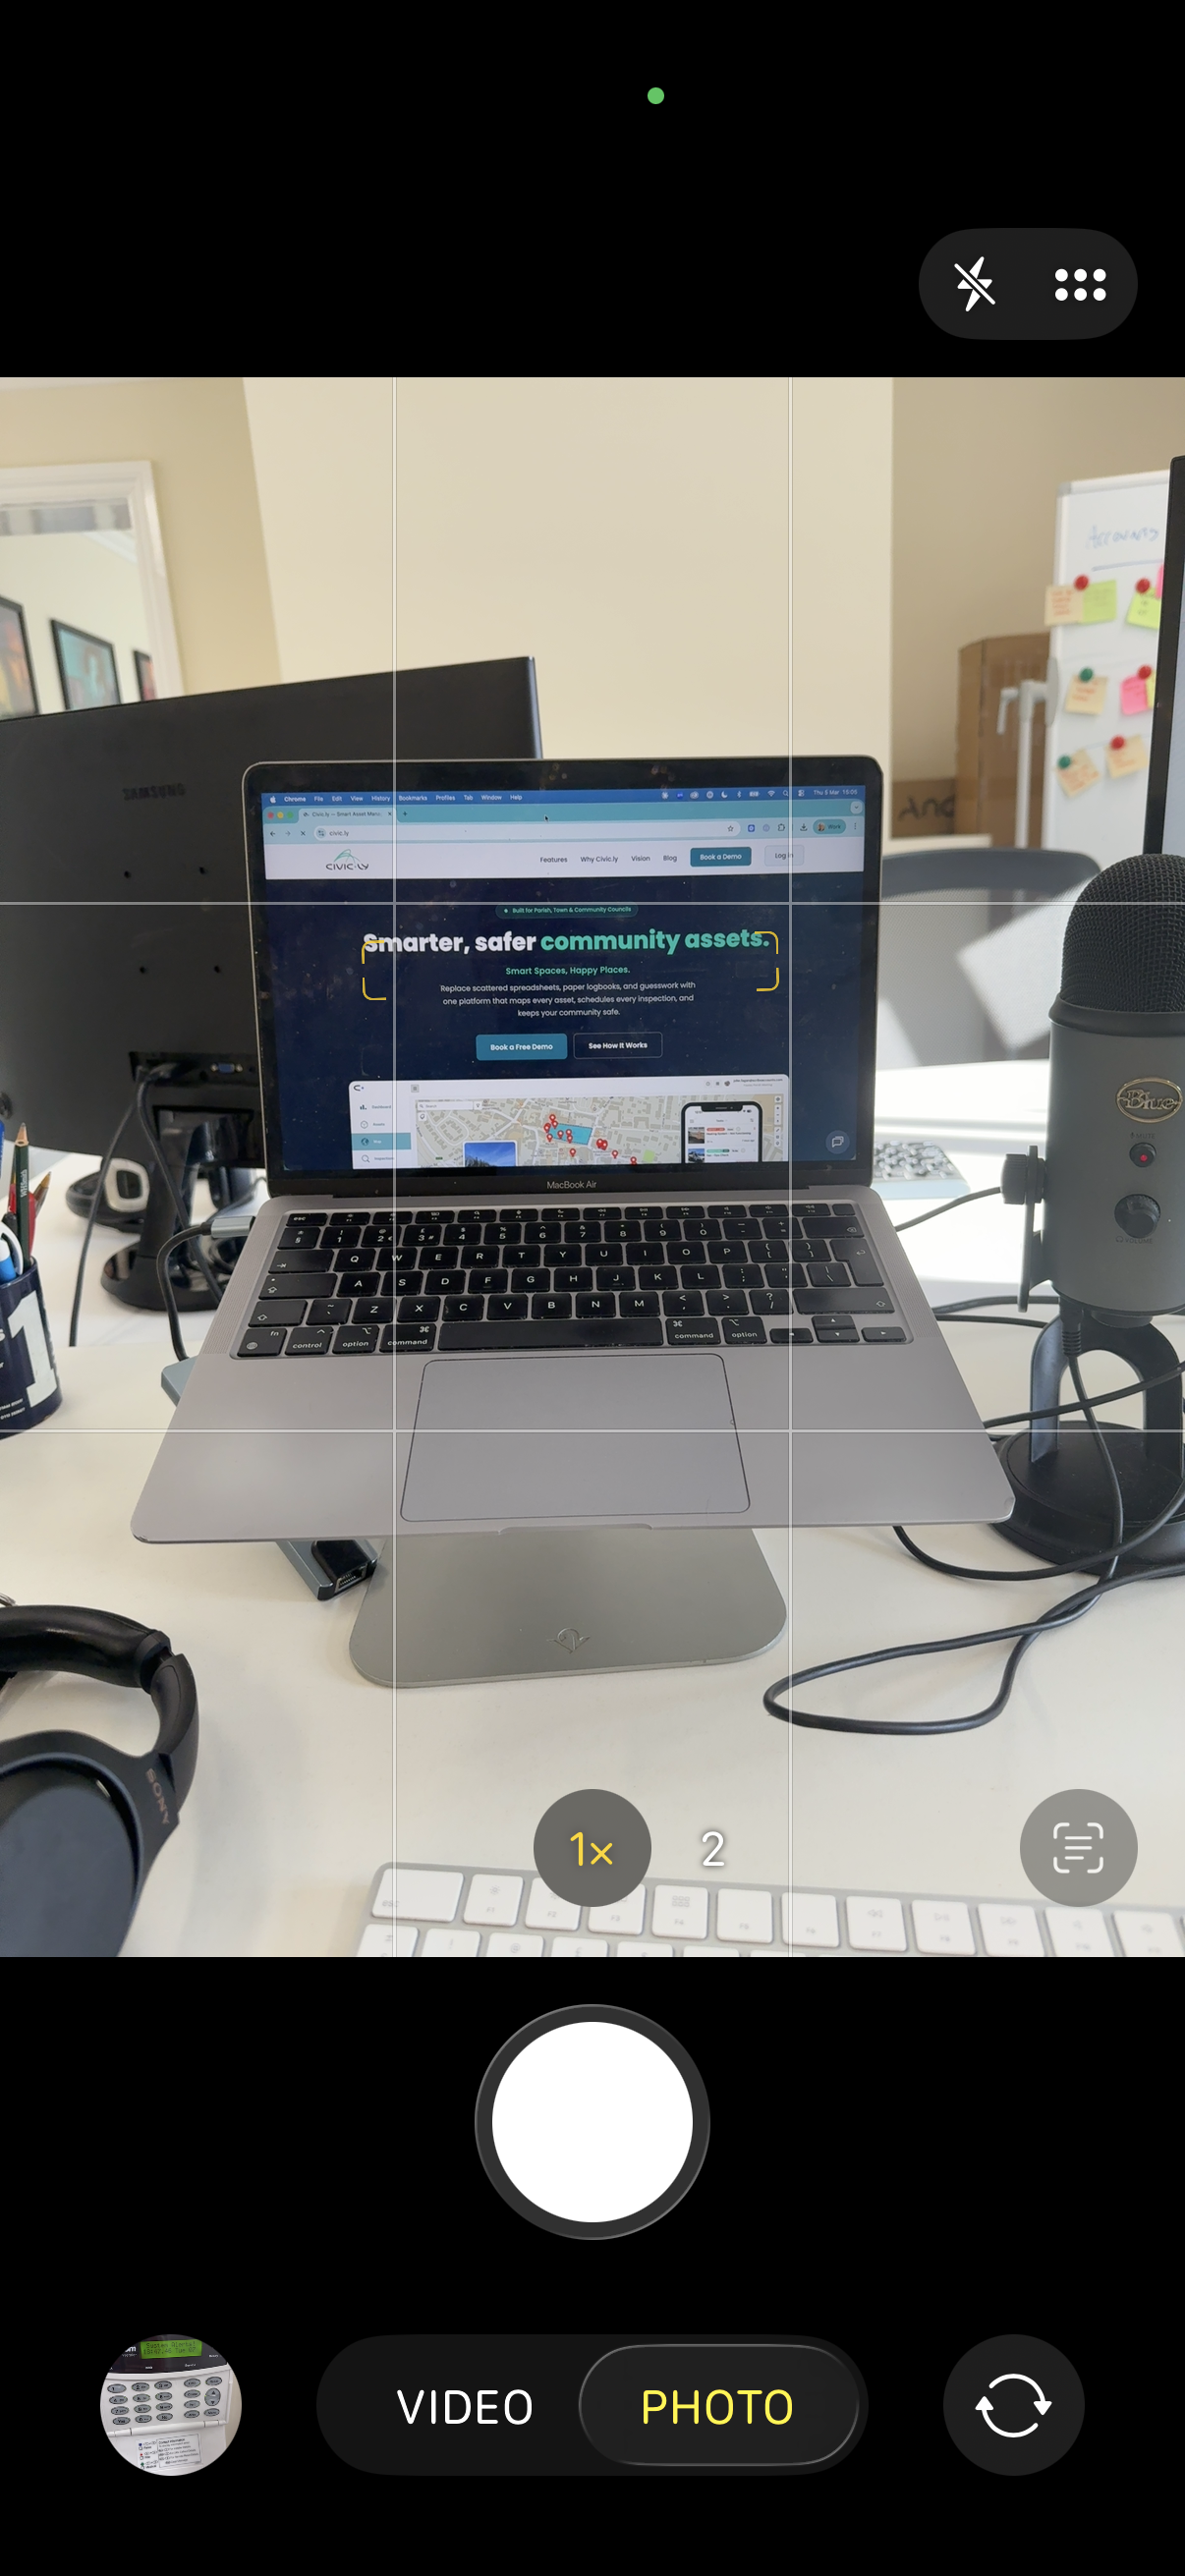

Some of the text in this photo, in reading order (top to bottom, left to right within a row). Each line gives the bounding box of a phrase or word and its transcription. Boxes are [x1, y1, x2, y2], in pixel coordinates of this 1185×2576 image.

[122, 782, 187, 802] SAMSUNG
[329, 829, 350, 838] civic.ly
[595, 855, 619, 864] Civic.ly
[662, 854, 678, 863] Blog
[700, 853, 716, 862] Book
[363, 928, 770, 955] Smarter, safer community assets.
[505, 965, 631, 977] Smart Spaces, Happy Places.
[440, 980, 696, 994] Replace scattered spreadsheets, paper logbooks, and guesswork with
[458, 996, 491, 1007] platform
[491, 996, 508, 1005] that
[509, 997, 532, 1007] maps
[532, 997, 553, 1007] every
[553, 996, 576, 1005] asset,
[577, 995, 615, 1004] schedules
[616, 995, 637, 1005] every
[638, 993, 678, 1003] inspection,
[517, 1009, 540, 1019] keeps
[540, 1009, 558, 1019] your
[558, 1008, 601, 1018] community
[1125, 1089, 1176, 1111] Blue
[546, 1180, 597, 1190] MacBook Air
[538, 1231, 546, 1240] 6
[350, 1255, 360, 1263] Q
[476, 1252, 483, 1260] R
[354, 1279, 363, 1288] A
[398, 1278, 407, 1287] S
[484, 1276, 491, 1285] F
[526, 1275, 535, 1284] G
[459, 1303, 468, 1312] C
[592, 1300, 600, 1309] N
[731, 1330, 758, 1339] option
[7, 1289, 58, 1408] 1
[342, 1340, 369, 1349] option
[145, 1767, 170, 1824] SONY
[381, 1899, 400, 1908] esc
